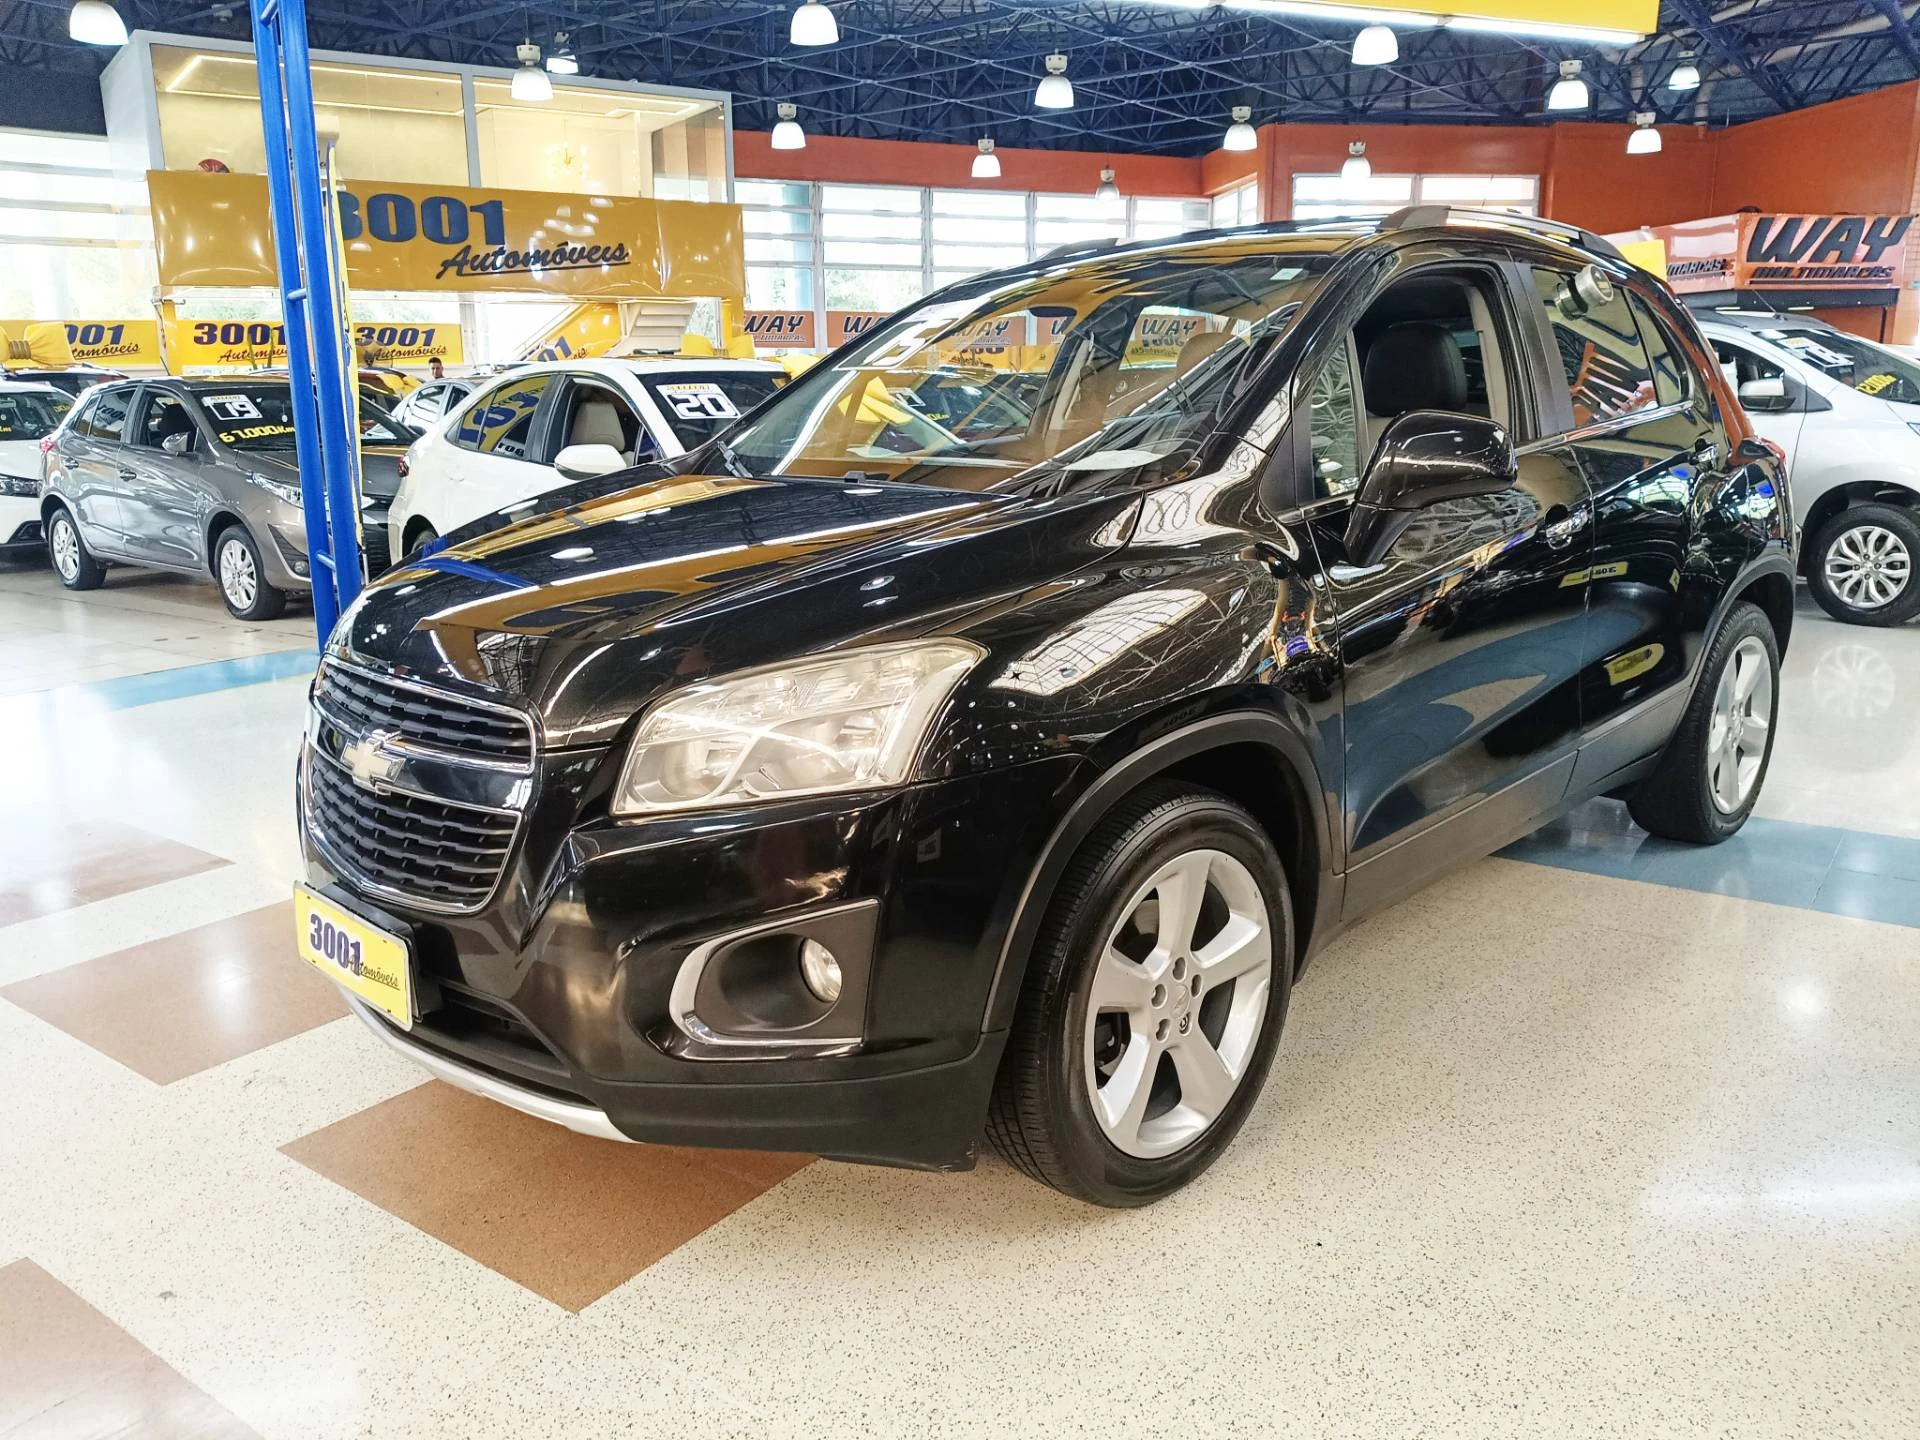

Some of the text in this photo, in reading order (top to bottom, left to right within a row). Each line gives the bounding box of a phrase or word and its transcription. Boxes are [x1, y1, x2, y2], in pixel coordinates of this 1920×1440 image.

[1747, 217, 1914, 263] WAY
[435, 241, 631, 279] Automóveis
[356, 326, 436, 347] 3001
[224, 401, 255, 419] 19
[671, 393, 737, 418] 20
[310, 913, 361, 977] 3001
